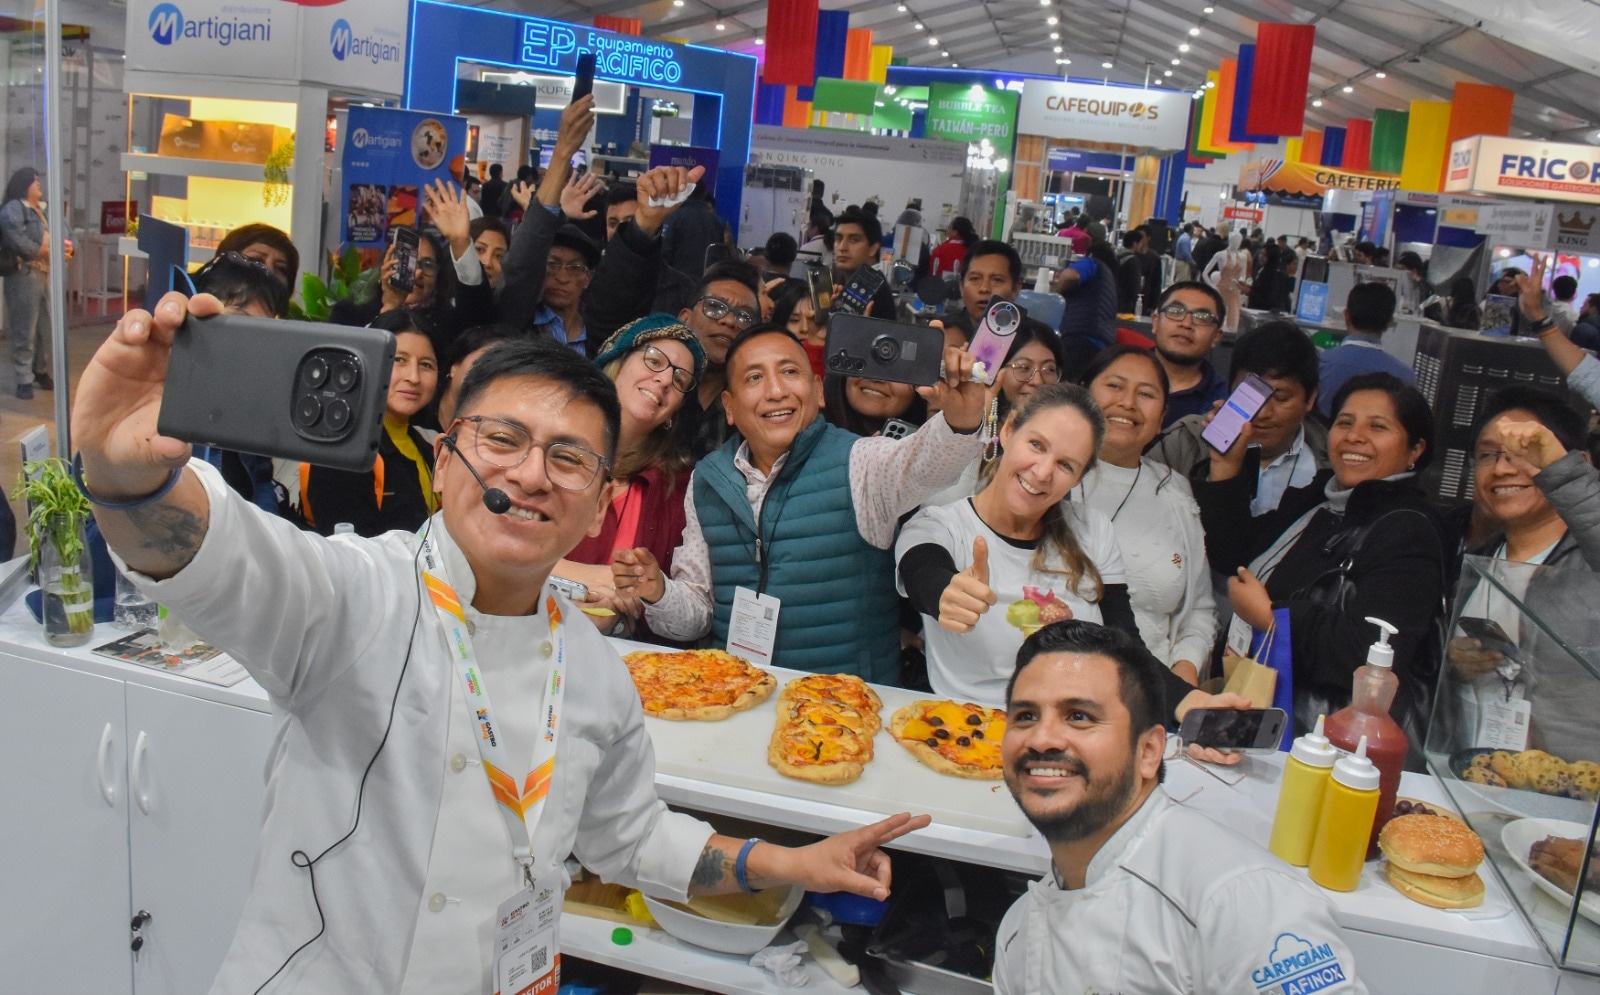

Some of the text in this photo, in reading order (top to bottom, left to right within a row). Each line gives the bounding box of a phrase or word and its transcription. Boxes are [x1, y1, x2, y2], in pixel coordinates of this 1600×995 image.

[149, 4, 271, 46] Martigiani
[330, 18, 401, 63] Martigiani
[522, 21, 576, 66] EP
[588, 32, 674, 59] Equipamiento
[939, 100, 1006, 114] BUBBLE TEA
[352, 128, 402, 149] Martigiani
[814, 158, 844, 167] YONG
[1557, 235, 1588, 246] KING
[485, 721, 497, 748] GASTRO
[1252, 943, 1334, 983] CARPIGIANI
[1288, 965, 1344, 995] AFINOX
